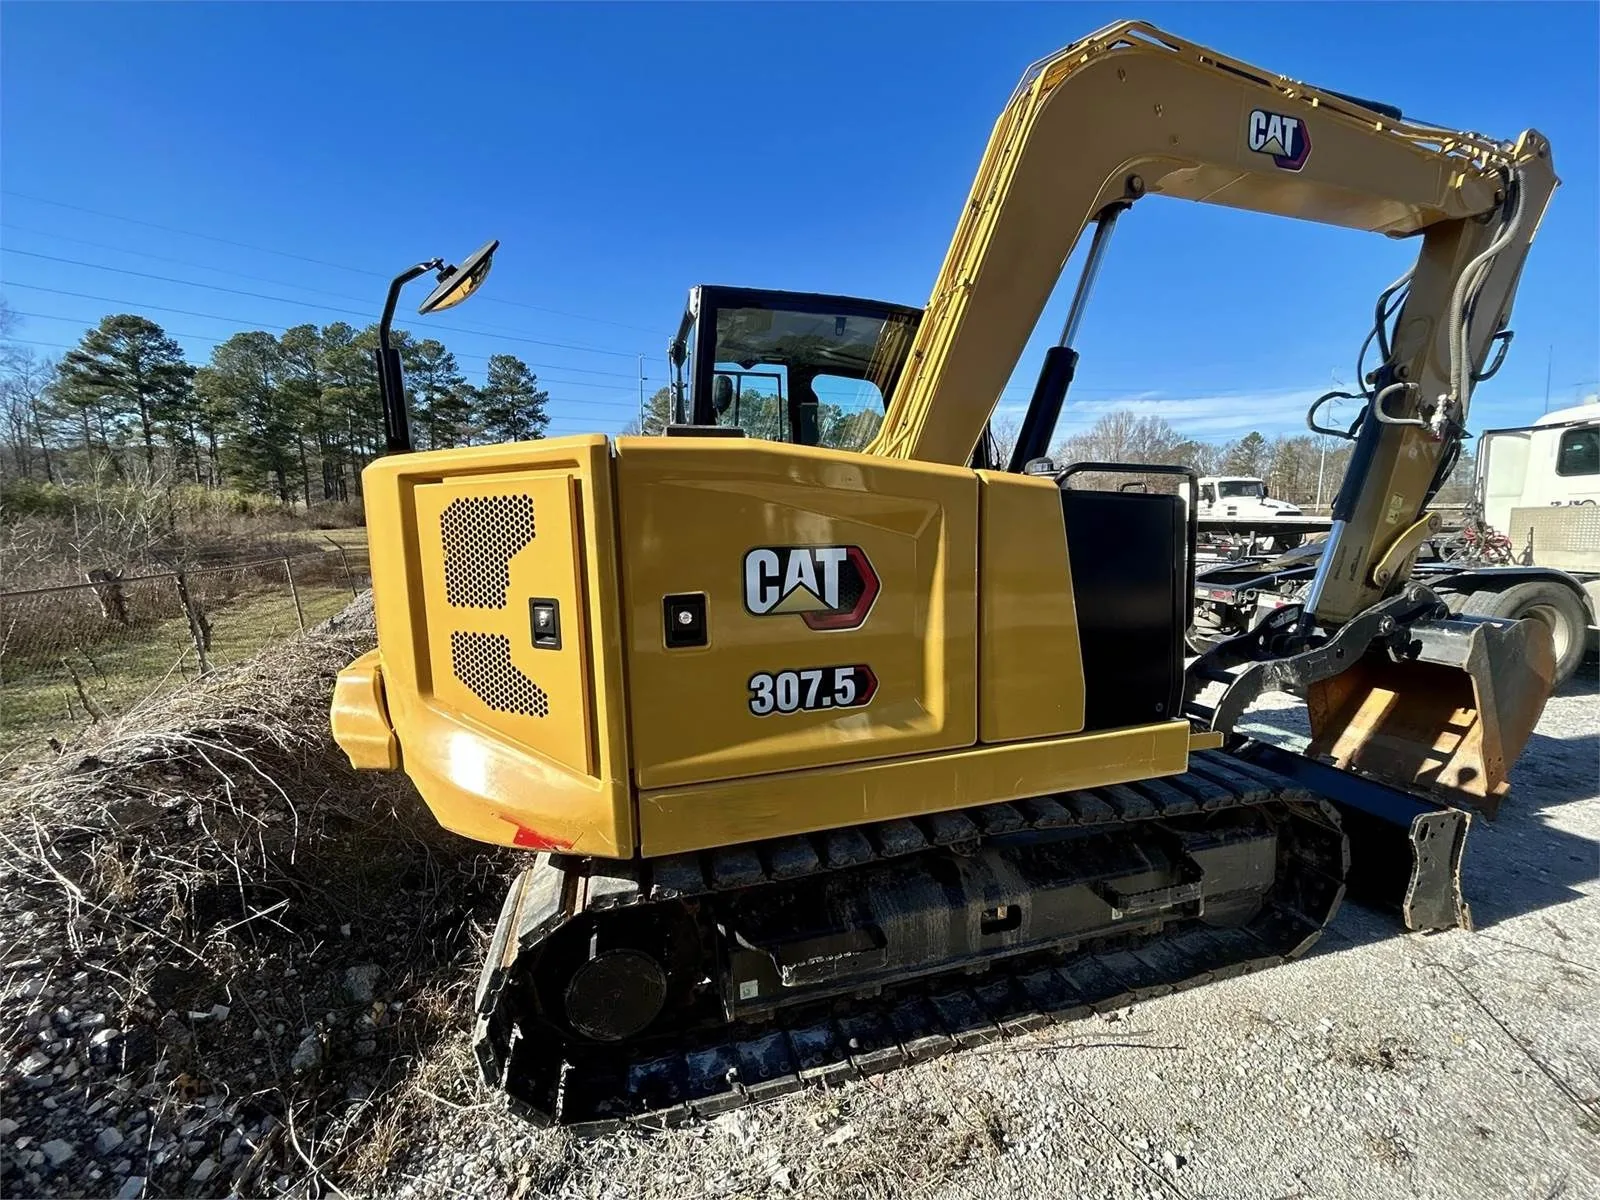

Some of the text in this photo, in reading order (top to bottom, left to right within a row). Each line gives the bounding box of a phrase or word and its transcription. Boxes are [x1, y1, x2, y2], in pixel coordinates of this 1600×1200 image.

[1249, 110, 1298, 157] CAT
[745, 547, 847, 614] CAT
[750, 667, 856, 714] 307.5
